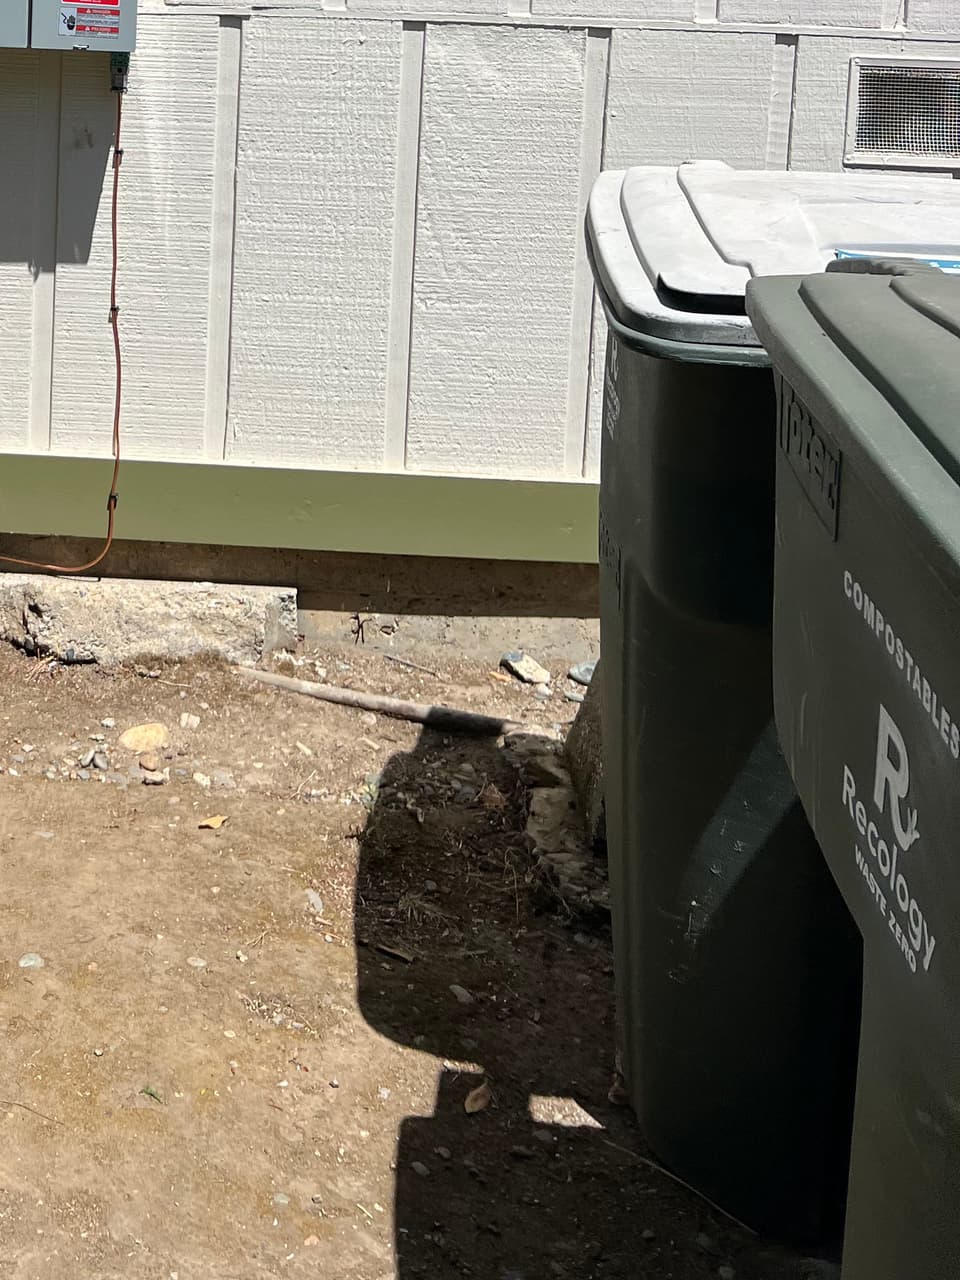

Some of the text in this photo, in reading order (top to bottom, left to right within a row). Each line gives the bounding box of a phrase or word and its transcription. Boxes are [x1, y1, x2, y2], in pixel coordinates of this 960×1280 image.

[843, 569, 959, 759] COMPOSTABLES
[842, 764, 936, 971] Recology
[854, 843, 917, 974] WASTE ZERO
